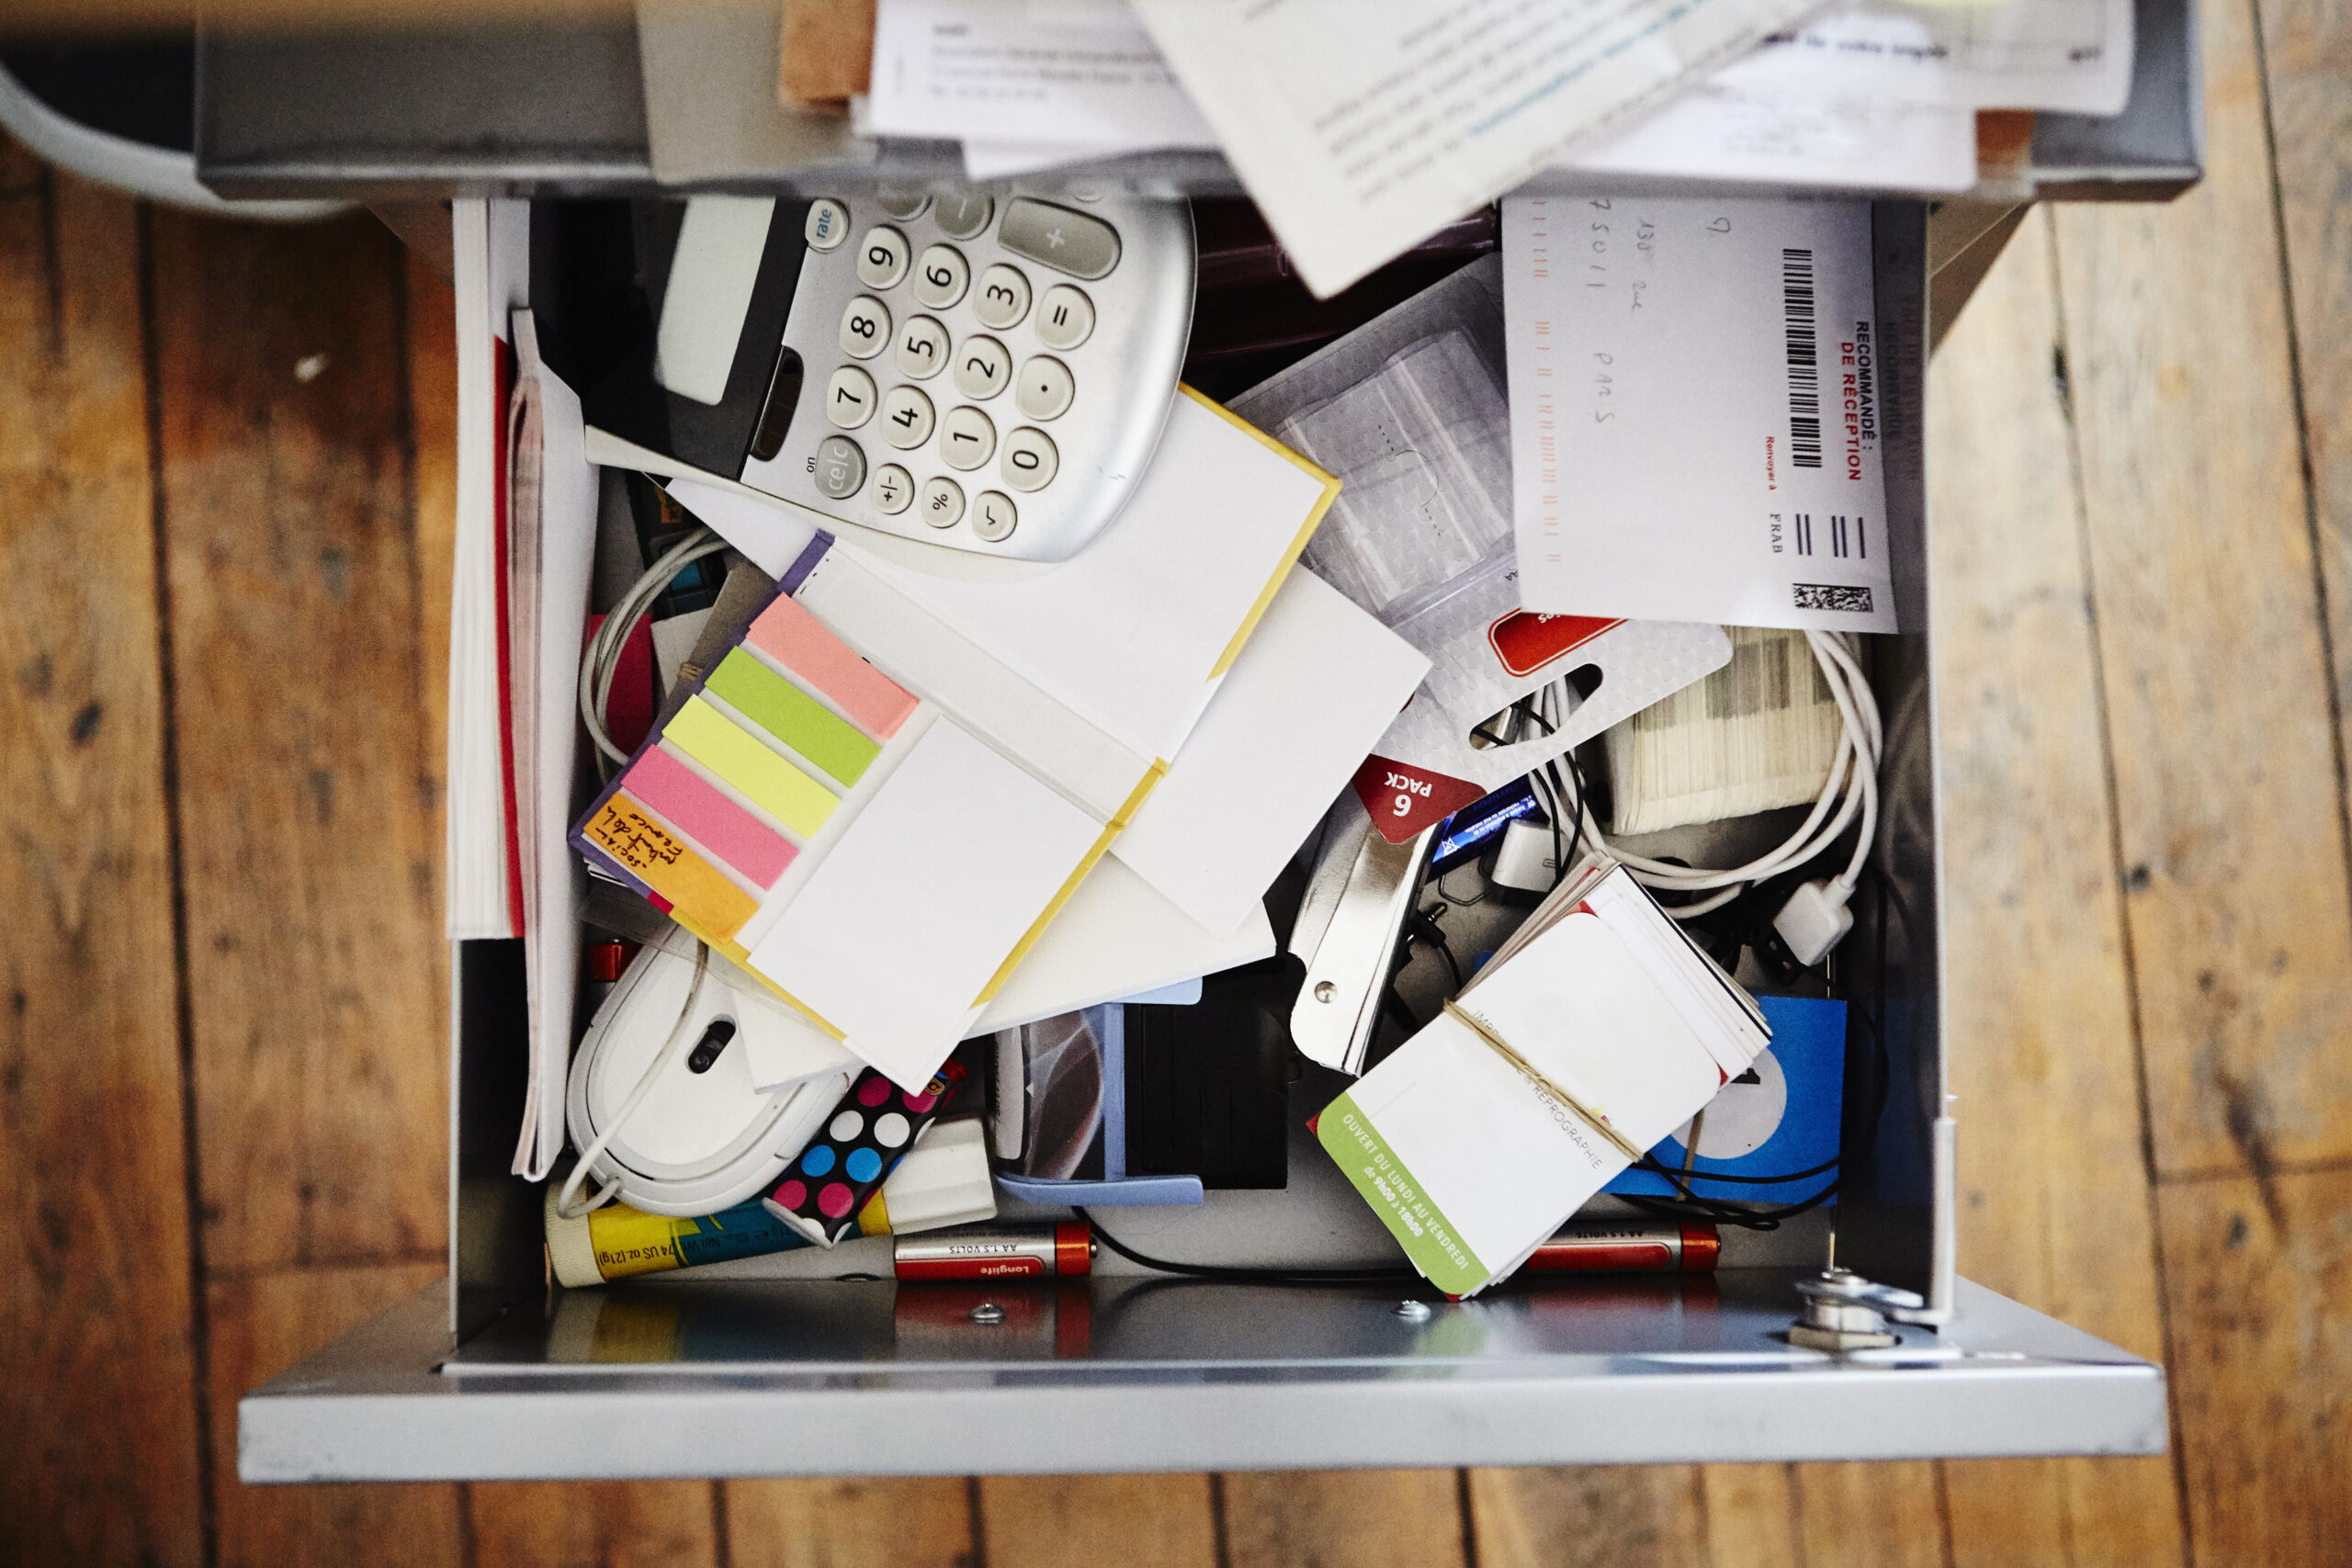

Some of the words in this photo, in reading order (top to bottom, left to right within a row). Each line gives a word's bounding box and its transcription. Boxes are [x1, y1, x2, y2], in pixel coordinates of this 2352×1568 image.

[815, 208, 832, 239] rate
[869, 246, 894, 266] 9
[926, 265, 952, 288] 6
[987, 285, 1014, 305] 3
[851, 316, 876, 338] 8
[908, 338, 933, 357] 5
[1841, 342, 1855, 367] DE
[967, 357, 994, 378] 2
[837, 387, 862, 404] 7
[892, 407, 919, 428] 4
[1842, 373, 1862, 481] RÉCEPTION
[953, 431, 979, 443] 1
[806, 456, 816, 473] on
[1012, 449, 1039, 470] 0
[1770, 513, 1783, 553] FRAB
[1384, 772, 1432, 796] PACK
[1393, 795, 1412, 816] 6
[1341, 1113, 1378, 1156] OUVERT
[1373, 1153, 1391, 1172] DU
[1386, 1169, 1417, 1204] LUNDI
[1411, 1201, 1429, 1220] AU
[1425, 1218, 1468, 1269] VENDREDI
[1363, 1164, 1378, 1179] de
[1372, 1175, 1396, 1203] 9h00
[1390, 1200, 1401, 1210] à
[1396, 1205, 1424, 1238] 18h00
[643, 1247, 659, 1259] US
[980, 1265, 1028, 1275] Longlife
